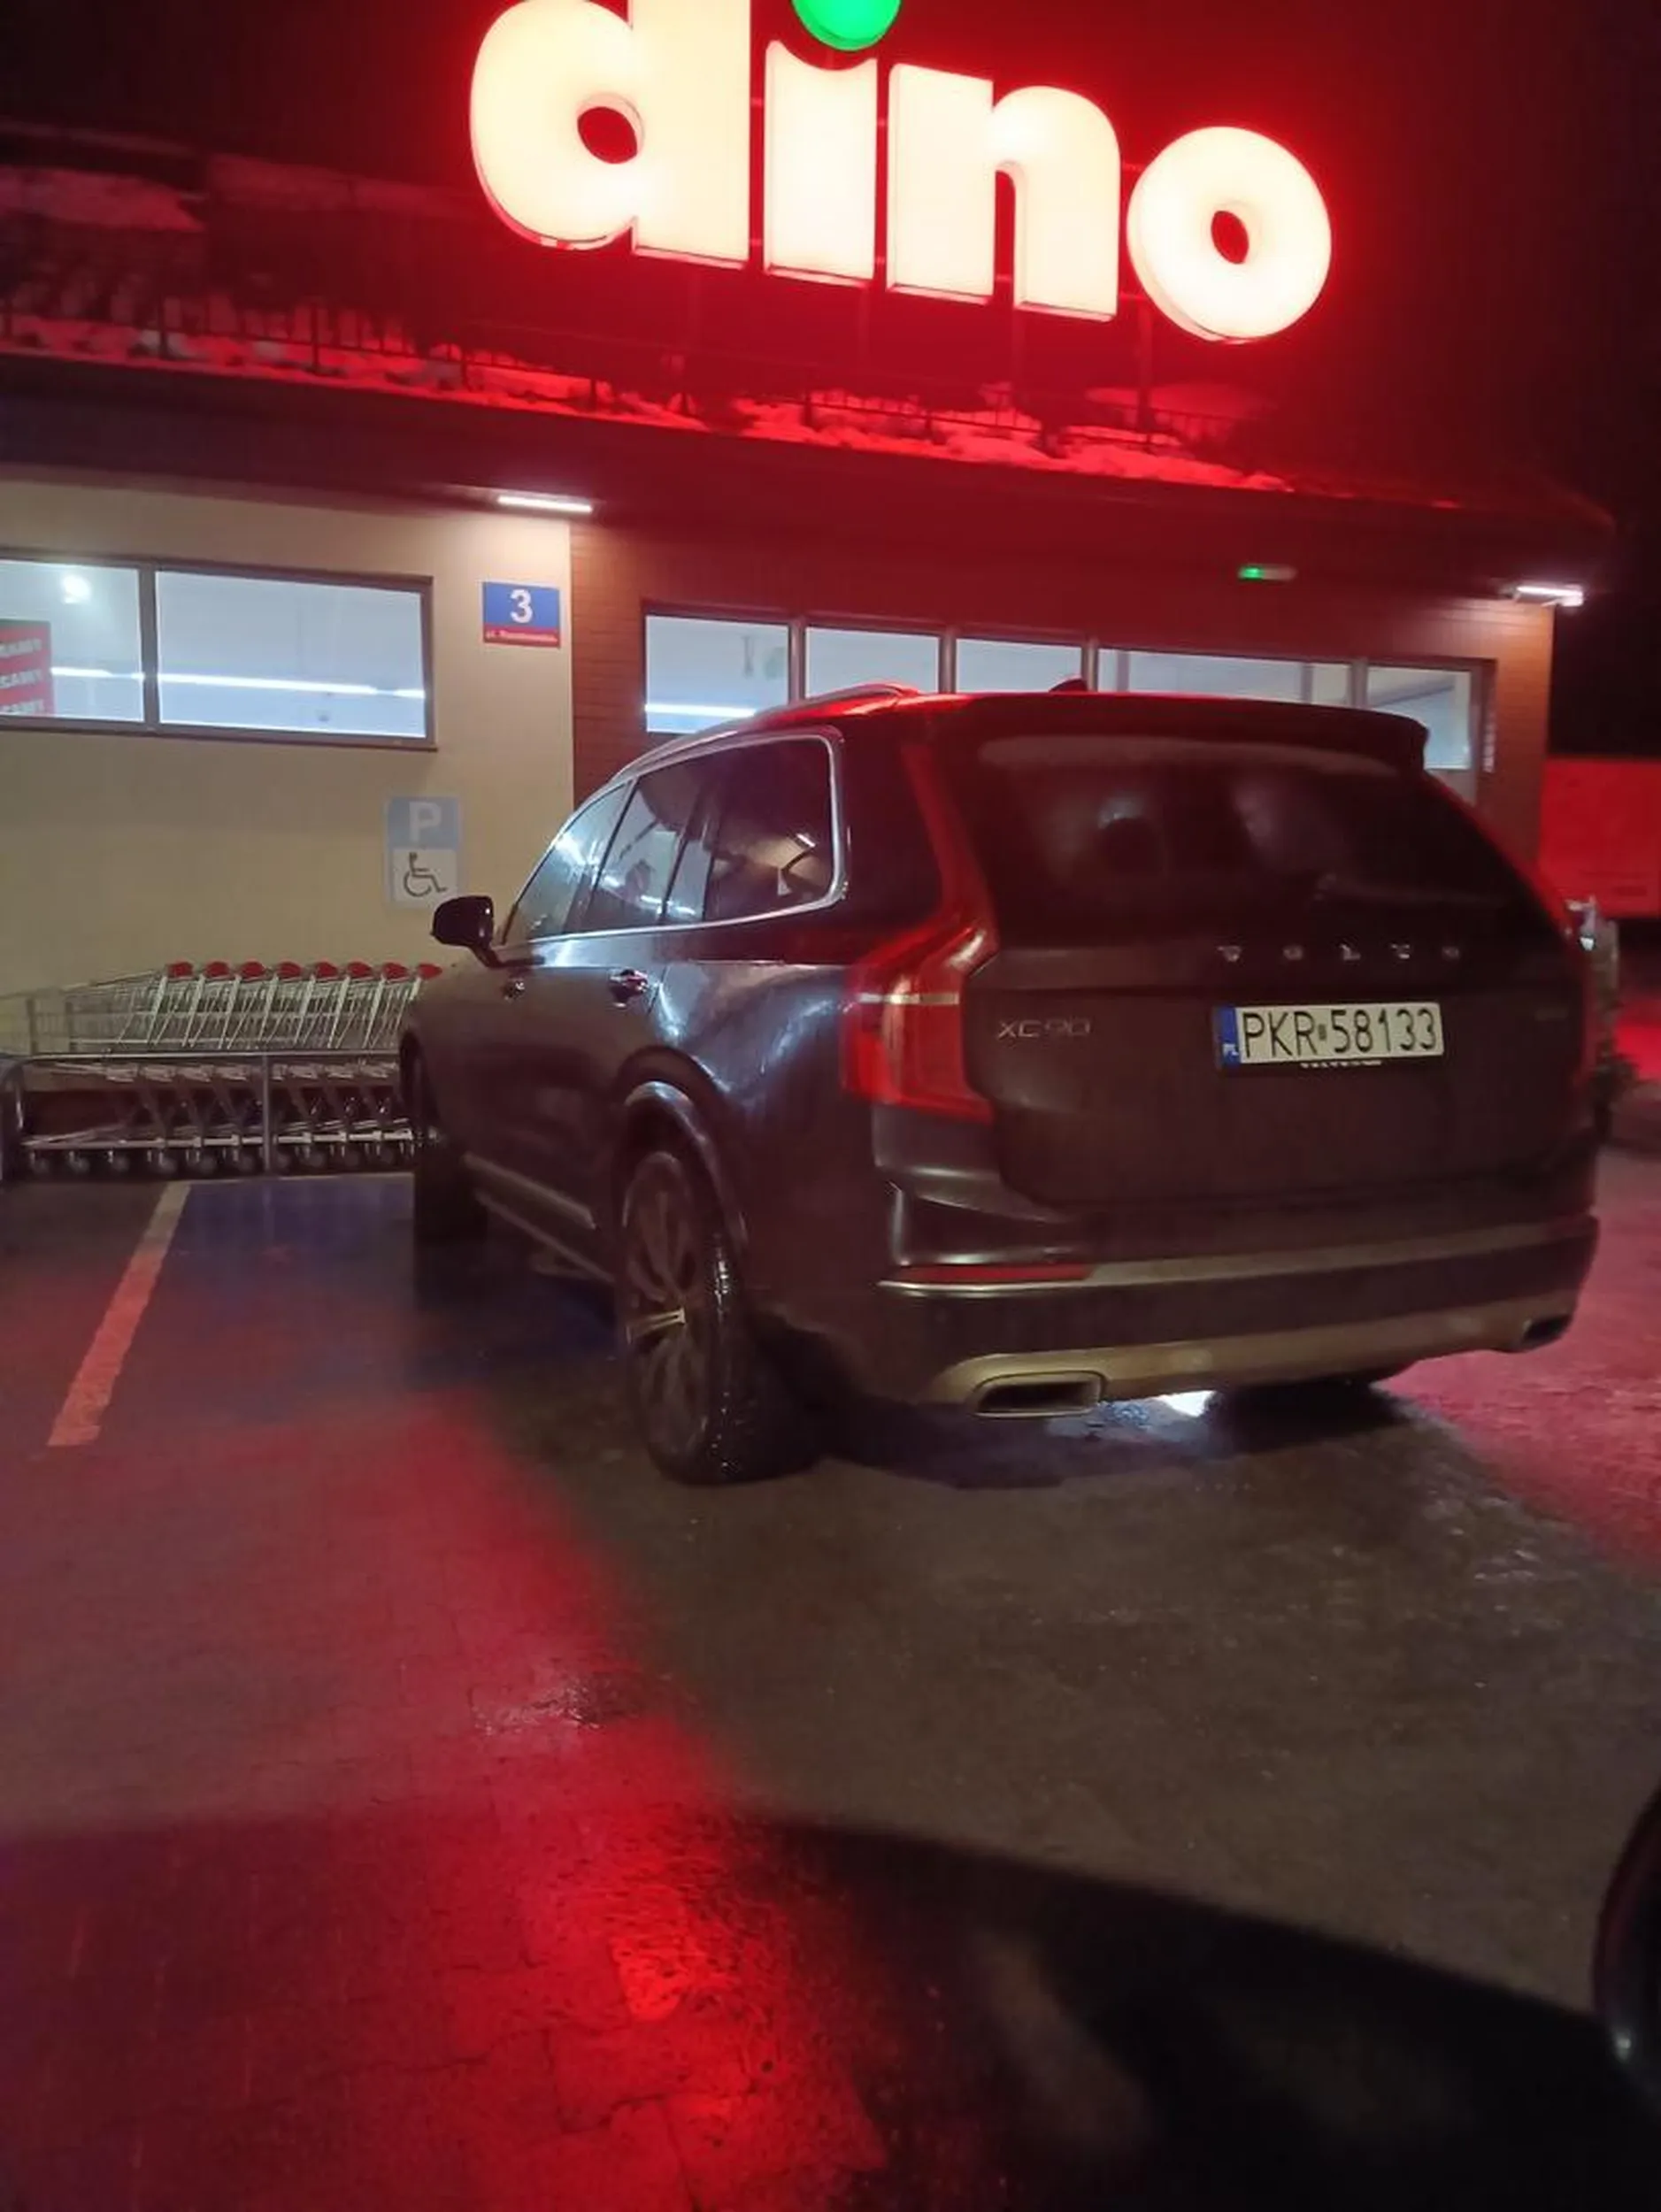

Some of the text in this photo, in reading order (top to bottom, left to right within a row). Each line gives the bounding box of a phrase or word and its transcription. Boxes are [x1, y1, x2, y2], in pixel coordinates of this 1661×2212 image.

[470, 0, 1333, 343] dino
[510, 588, 534, 624] 3
[409, 801, 442, 843] P
[1218, 943, 1460, 963] VOLVO
[1242, 1008, 1437, 1058] PKR 58133
